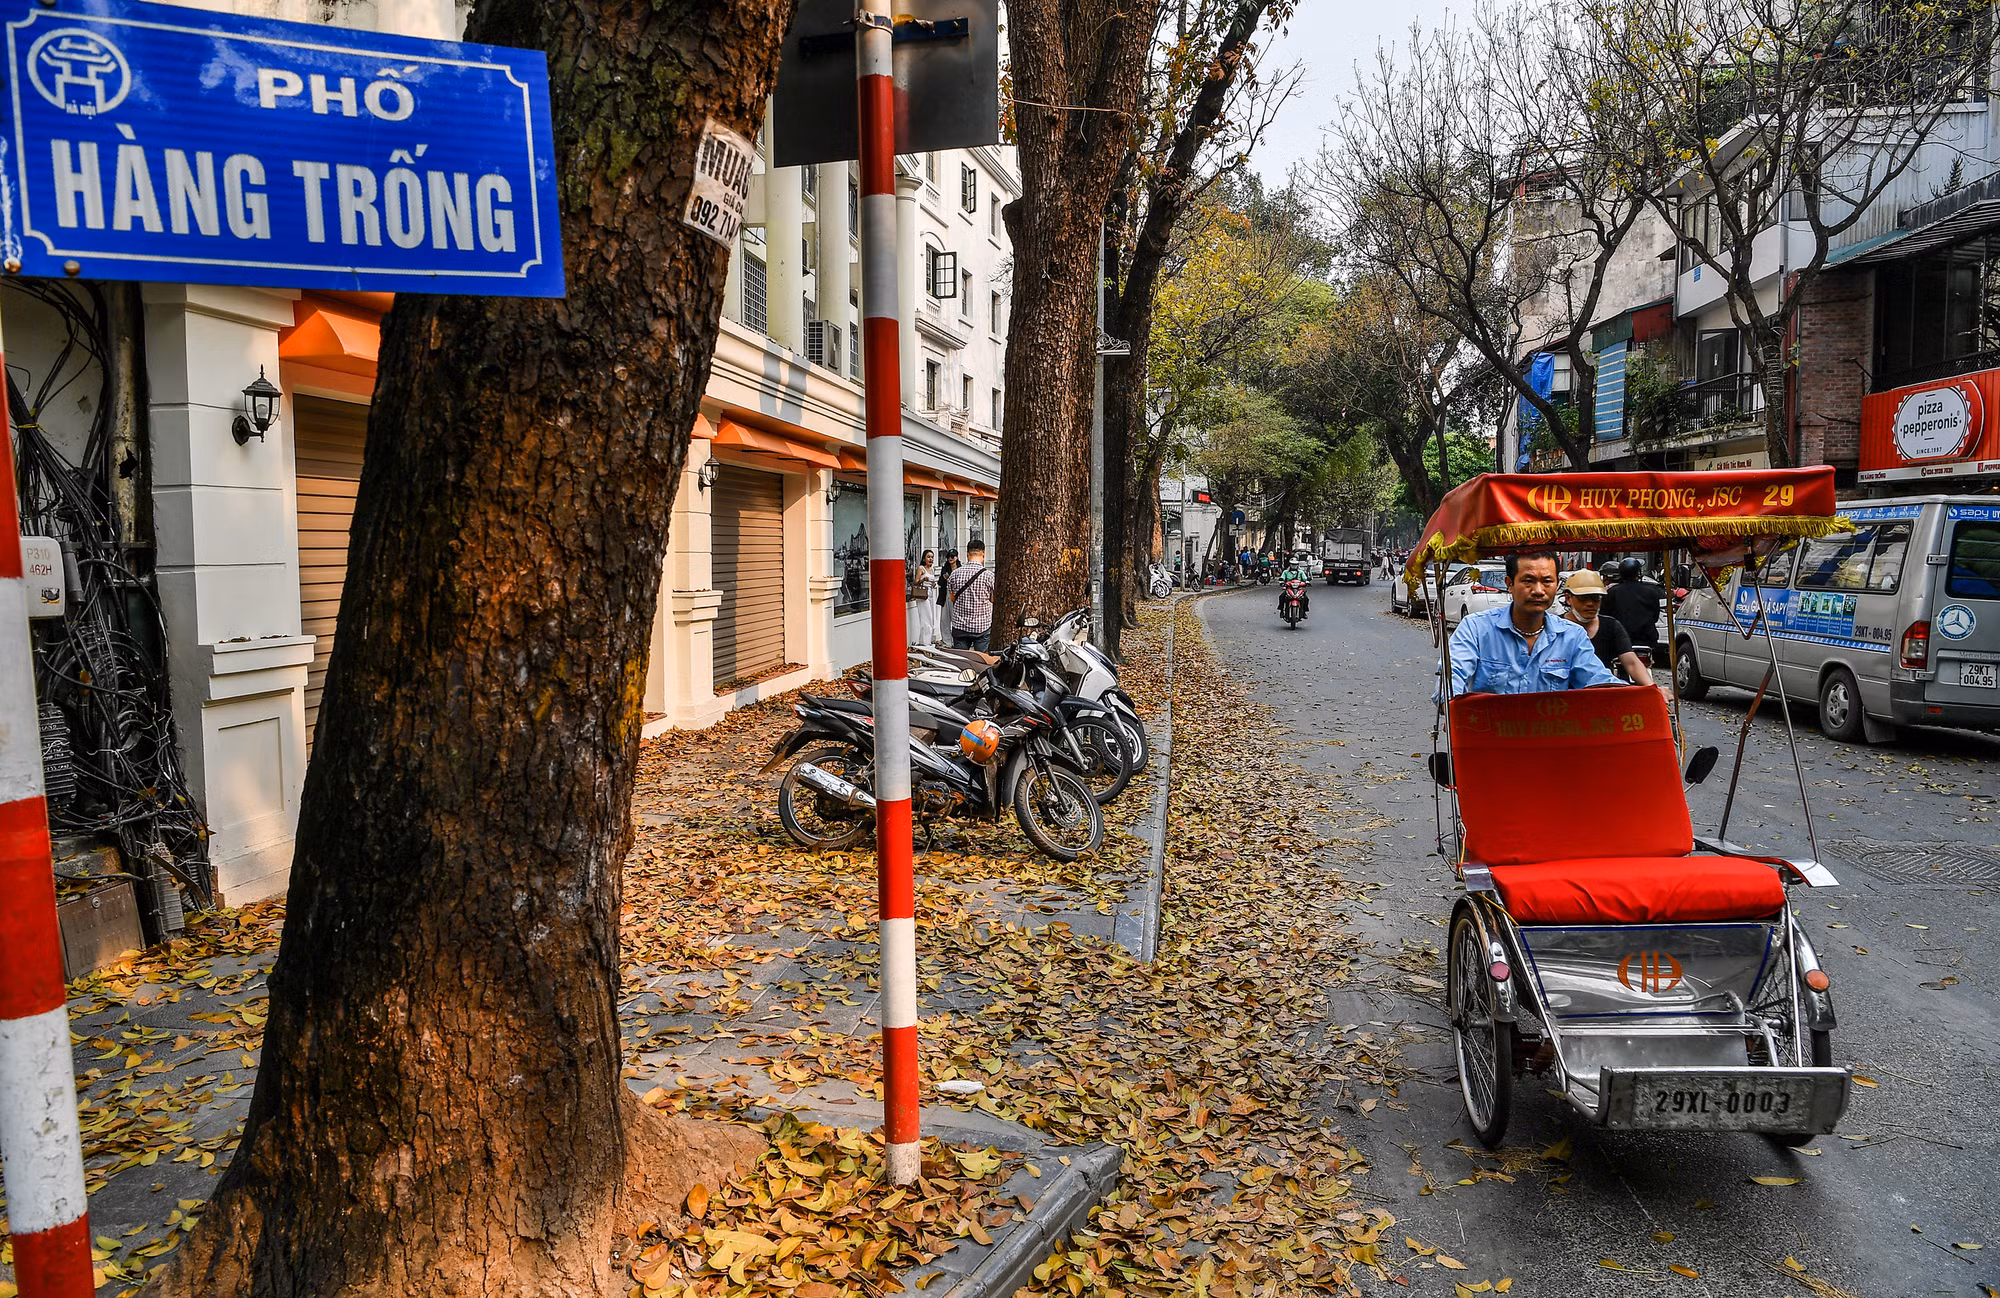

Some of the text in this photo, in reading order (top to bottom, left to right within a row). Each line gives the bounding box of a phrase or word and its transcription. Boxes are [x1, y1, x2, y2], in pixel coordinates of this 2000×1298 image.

[257, 65, 418, 121] PHỐ
[50, 123, 517, 253] HÀNG TRỐNG
[691, 195, 719, 231] 092
[1918, 400, 1943, 420] pizza
[1903, 413, 1958, 438] pepperonis
[1579, 488, 1620, 509] HUY
[1763, 484, 1794, 507] 29
[1960, 509, 1989, 518] sapy
[27, 547, 50, 560] P310
[30, 564, 52, 576] 462H
[1855, 625, 1868, 638] 29KT
[1872, 627, 1893, 641] 004.95
[1968, 664, 1990, 676] 29KT
[1963, 674, 1993, 686] 004.95
[1621, 713, 1645, 731] 29
[1655, 1090, 1791, 1114] 29XL-0003
